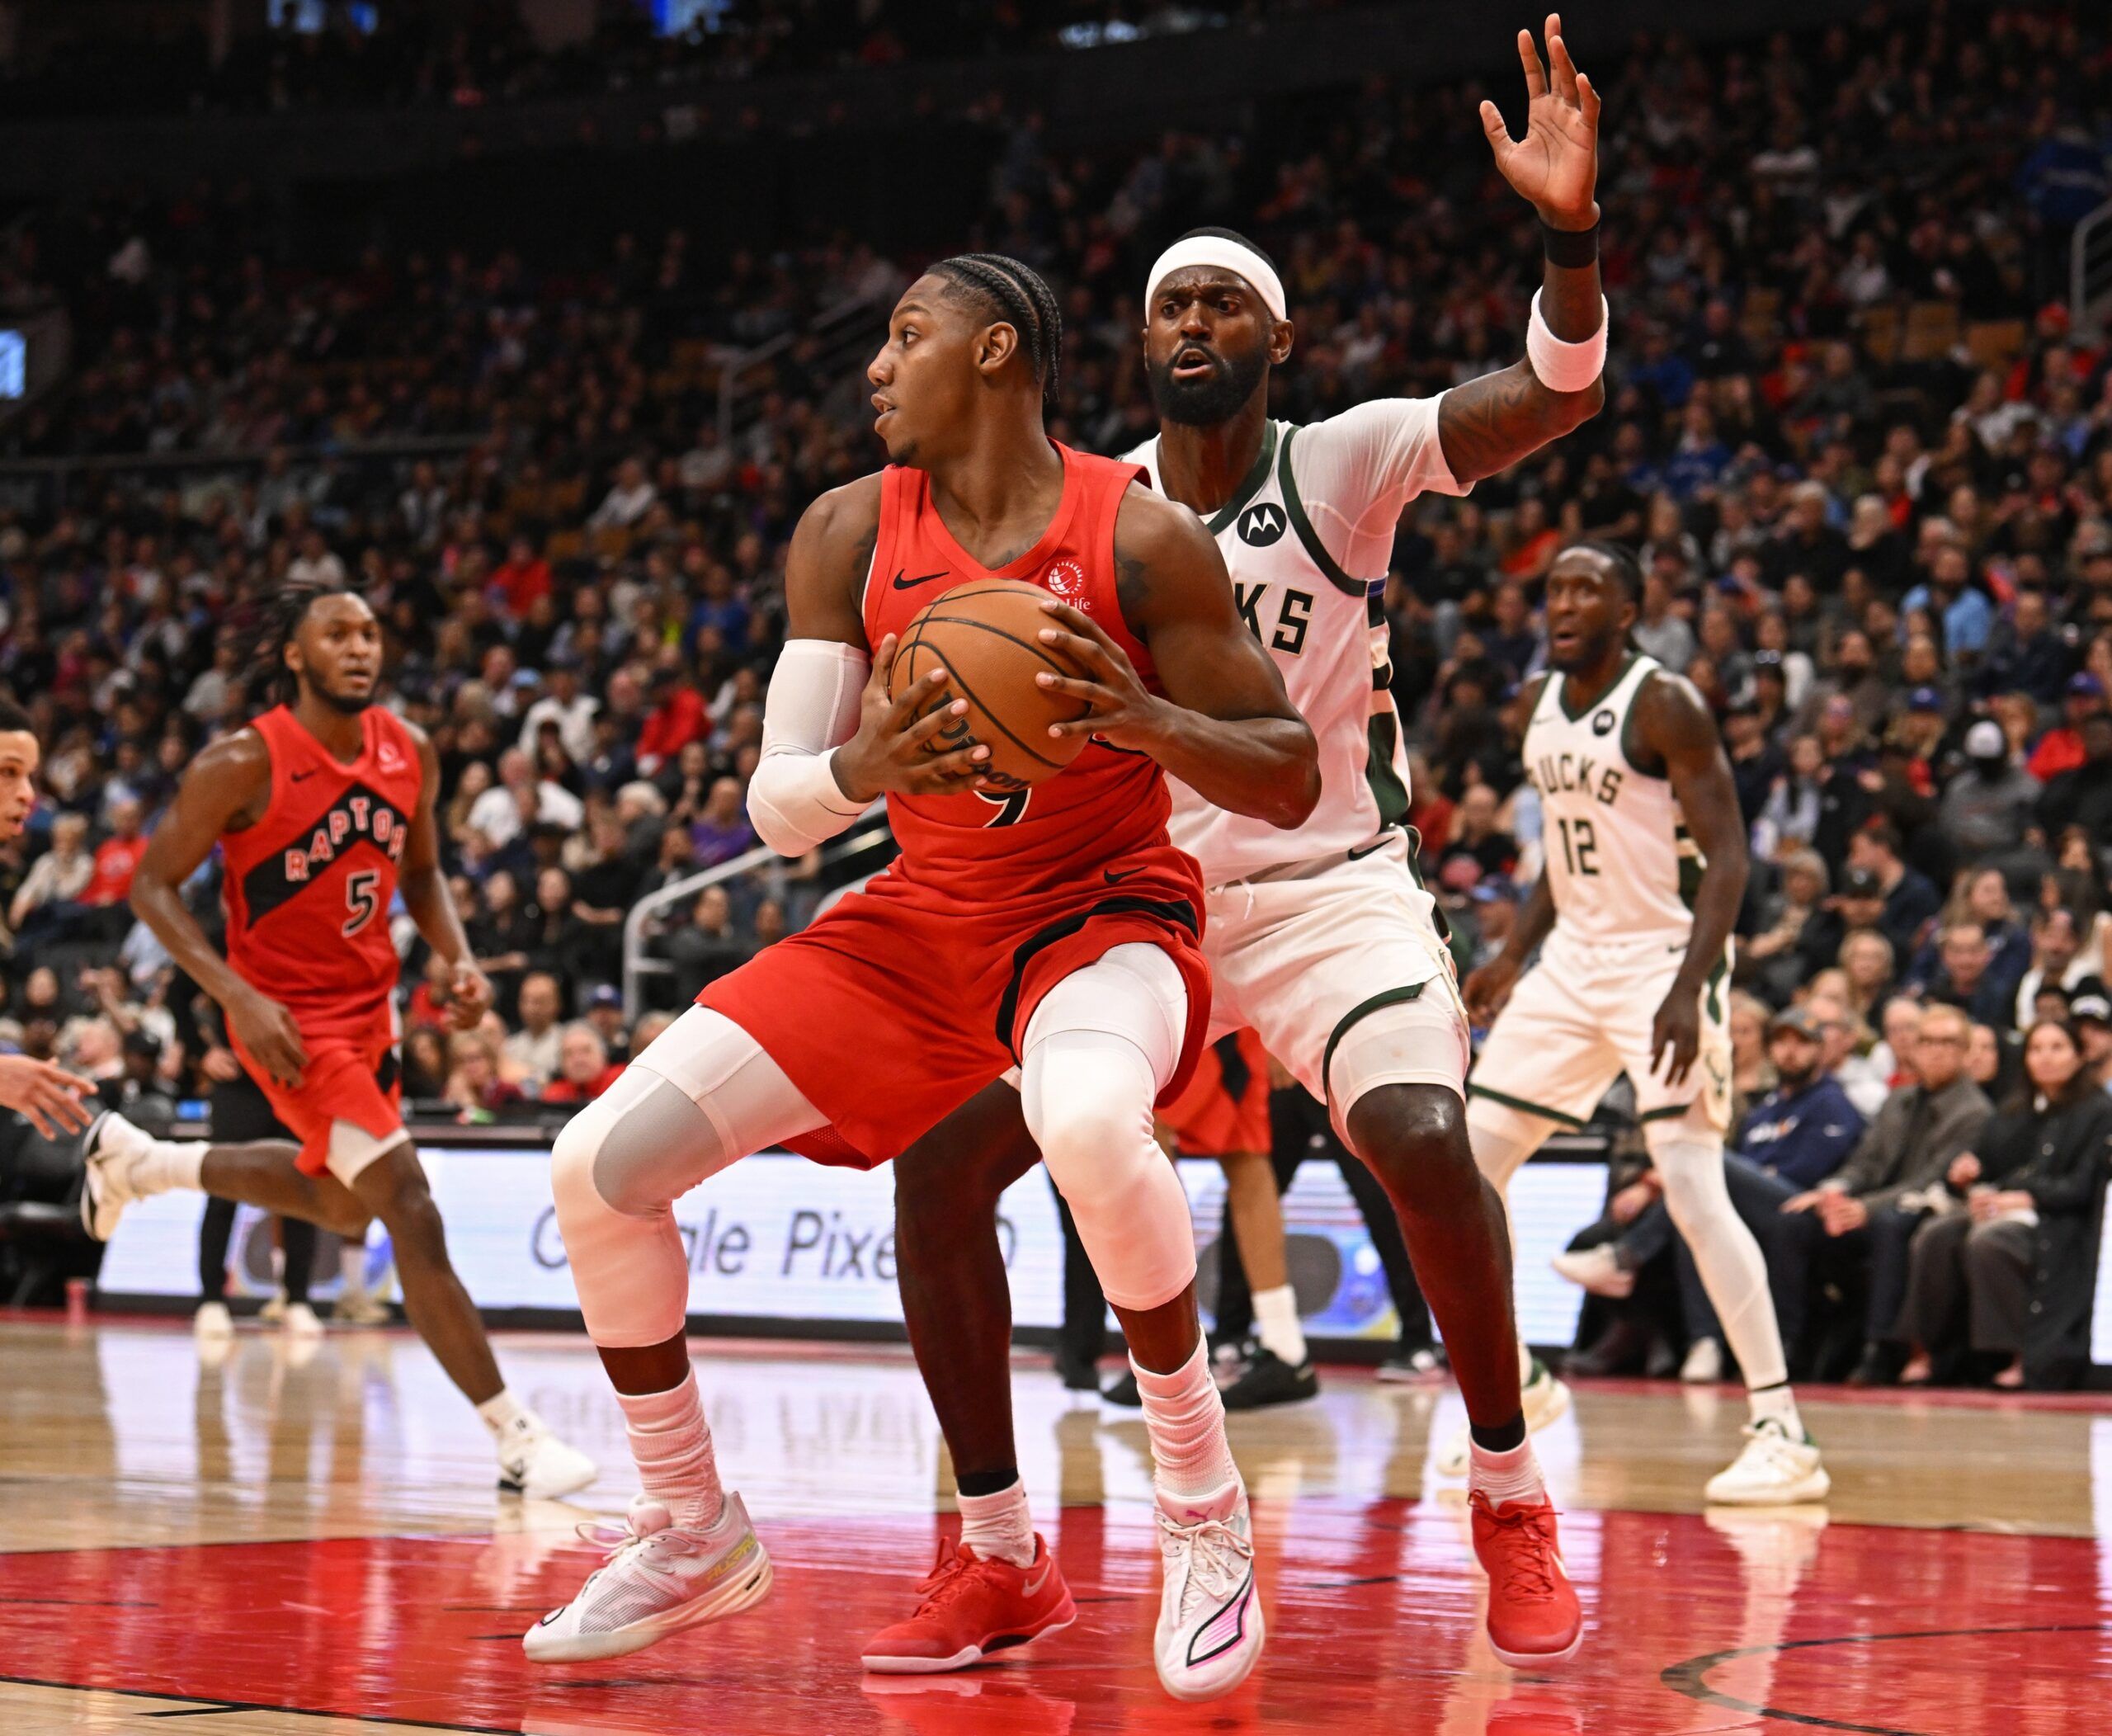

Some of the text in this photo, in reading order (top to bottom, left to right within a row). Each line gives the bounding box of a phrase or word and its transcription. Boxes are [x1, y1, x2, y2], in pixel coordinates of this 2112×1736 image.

[1558, 818, 1600, 875] 12
[342, 868, 380, 938] 5
[782, 1210, 897, 1280] Pixe
